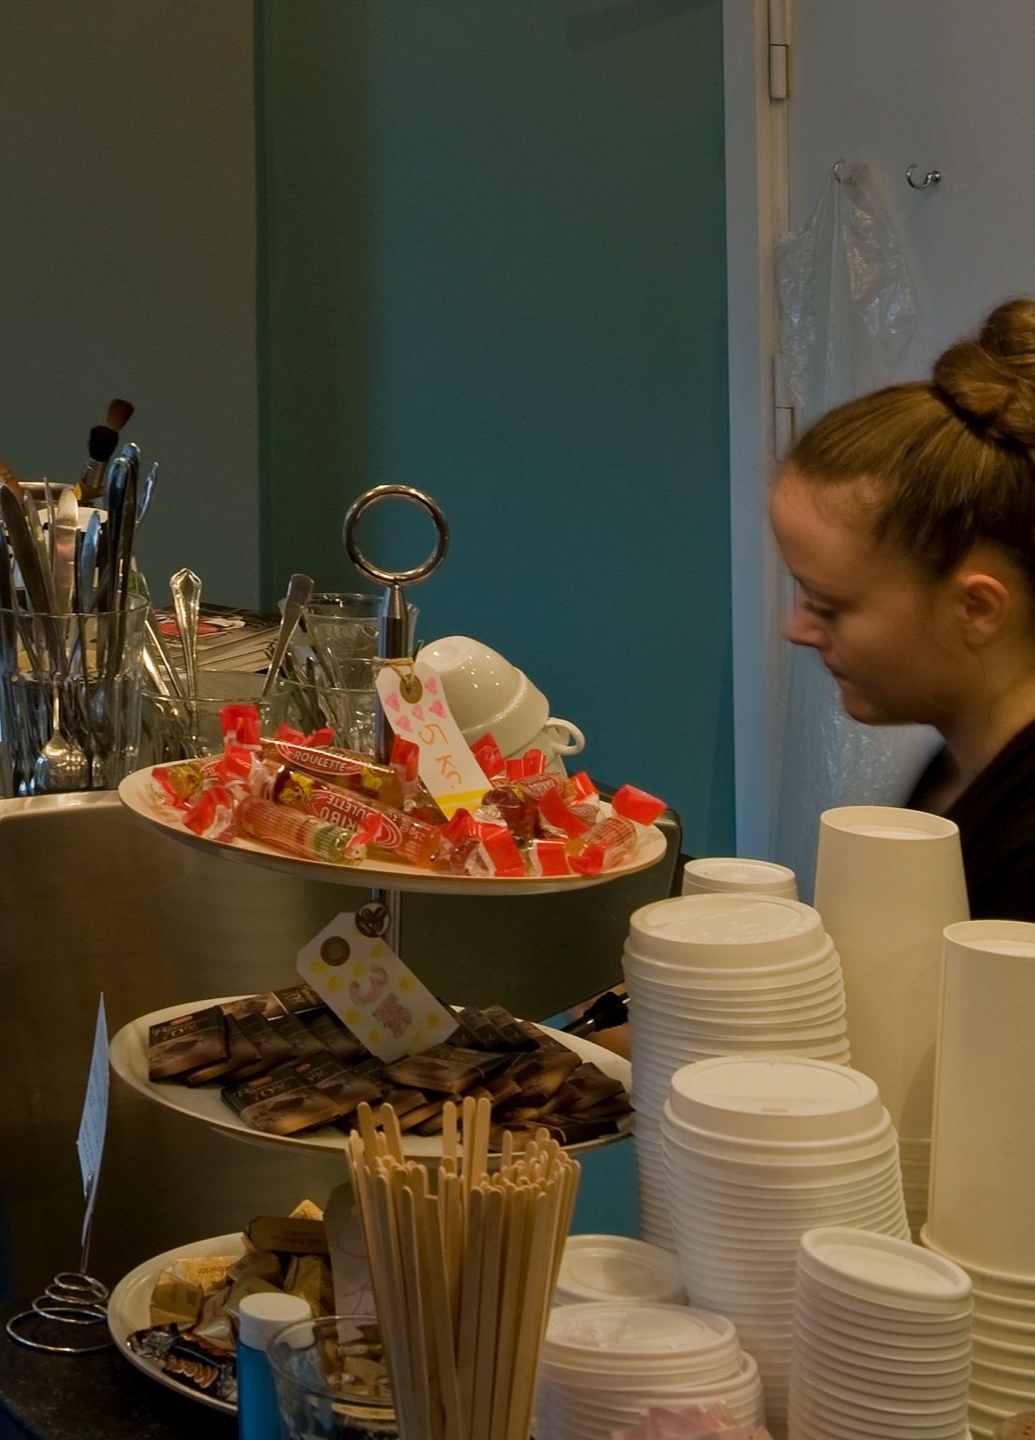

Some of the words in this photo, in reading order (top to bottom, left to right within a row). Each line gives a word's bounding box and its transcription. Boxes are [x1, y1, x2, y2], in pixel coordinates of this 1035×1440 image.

[418, 723, 449, 746] 5
[292, 750, 348, 772] ROULETTE
[319, 806, 360, 834] RIBO
